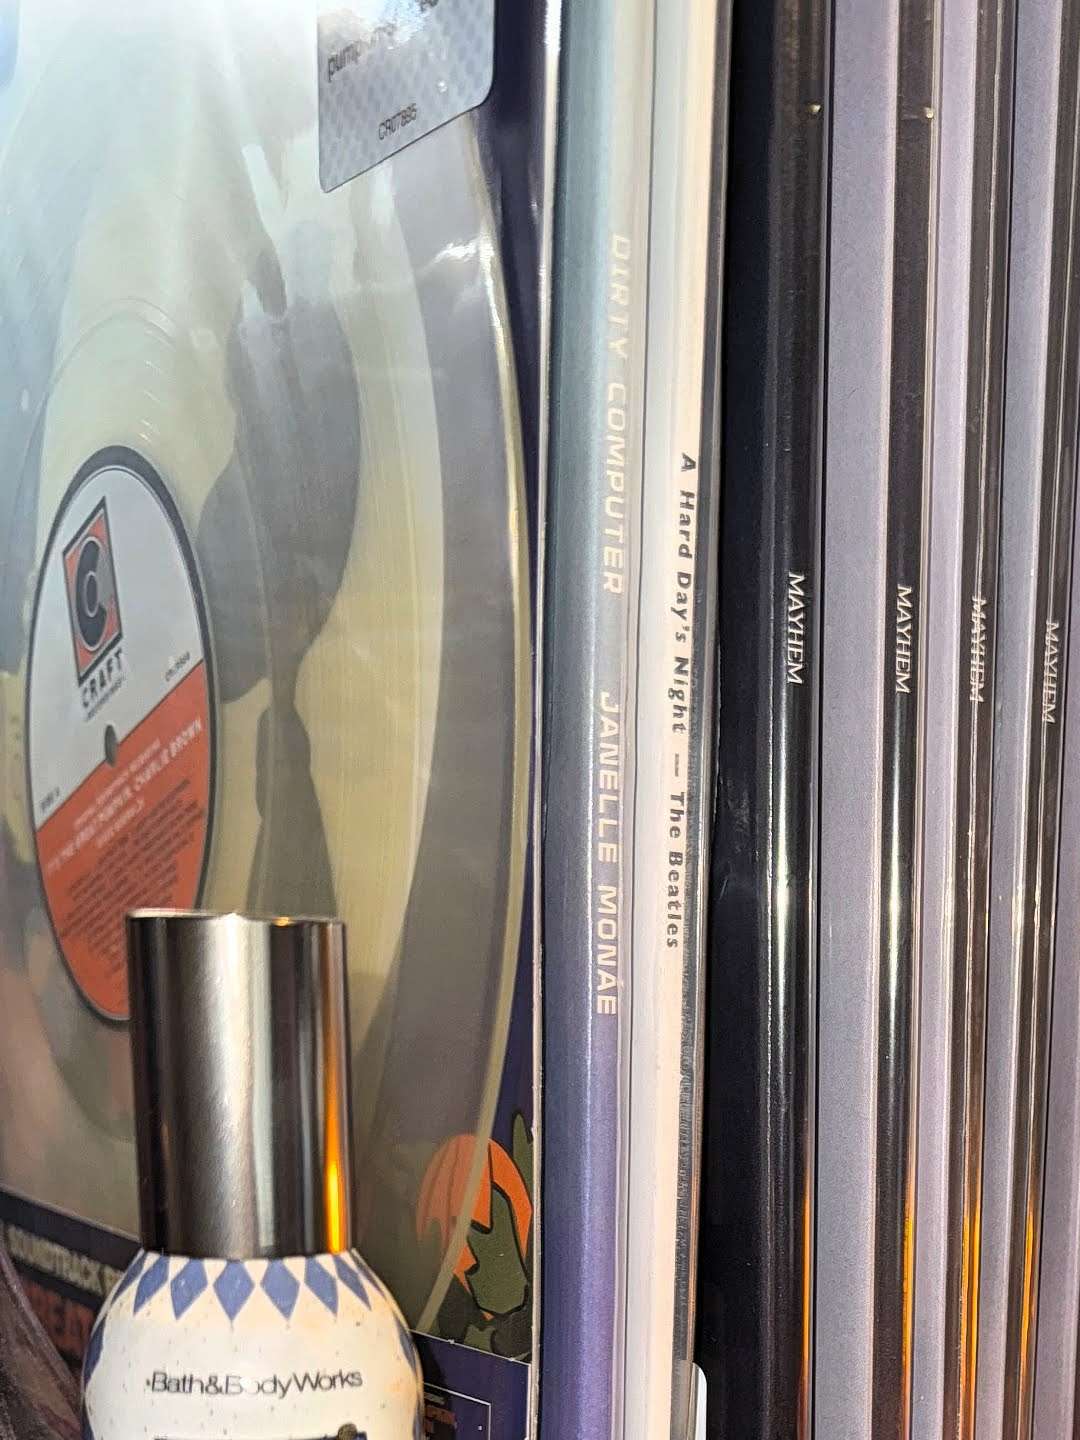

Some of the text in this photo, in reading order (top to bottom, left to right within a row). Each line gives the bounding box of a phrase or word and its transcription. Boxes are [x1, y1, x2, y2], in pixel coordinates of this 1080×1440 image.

[602, 233, 632, 596] DIRTY COMPUTER
[680, 452, 697, 473] A
[677, 489, 696, 559] Hard
[671, 571, 694, 643] Day's
[785, 571, 806, 686] MAYHEM
[893, 583, 913, 695] MAYHEM
[967, 596, 988, 705] MAYHEM
[81, 646, 123, 708] CRAFT
[668, 655, 691, 735] Night
[1040, 620, 1060, 725] MAYHEM
[595, 691, 625, 1016] JANELLE MONÁE
[668, 791, 686, 840] The
[665, 850, 685, 950] Beatles
